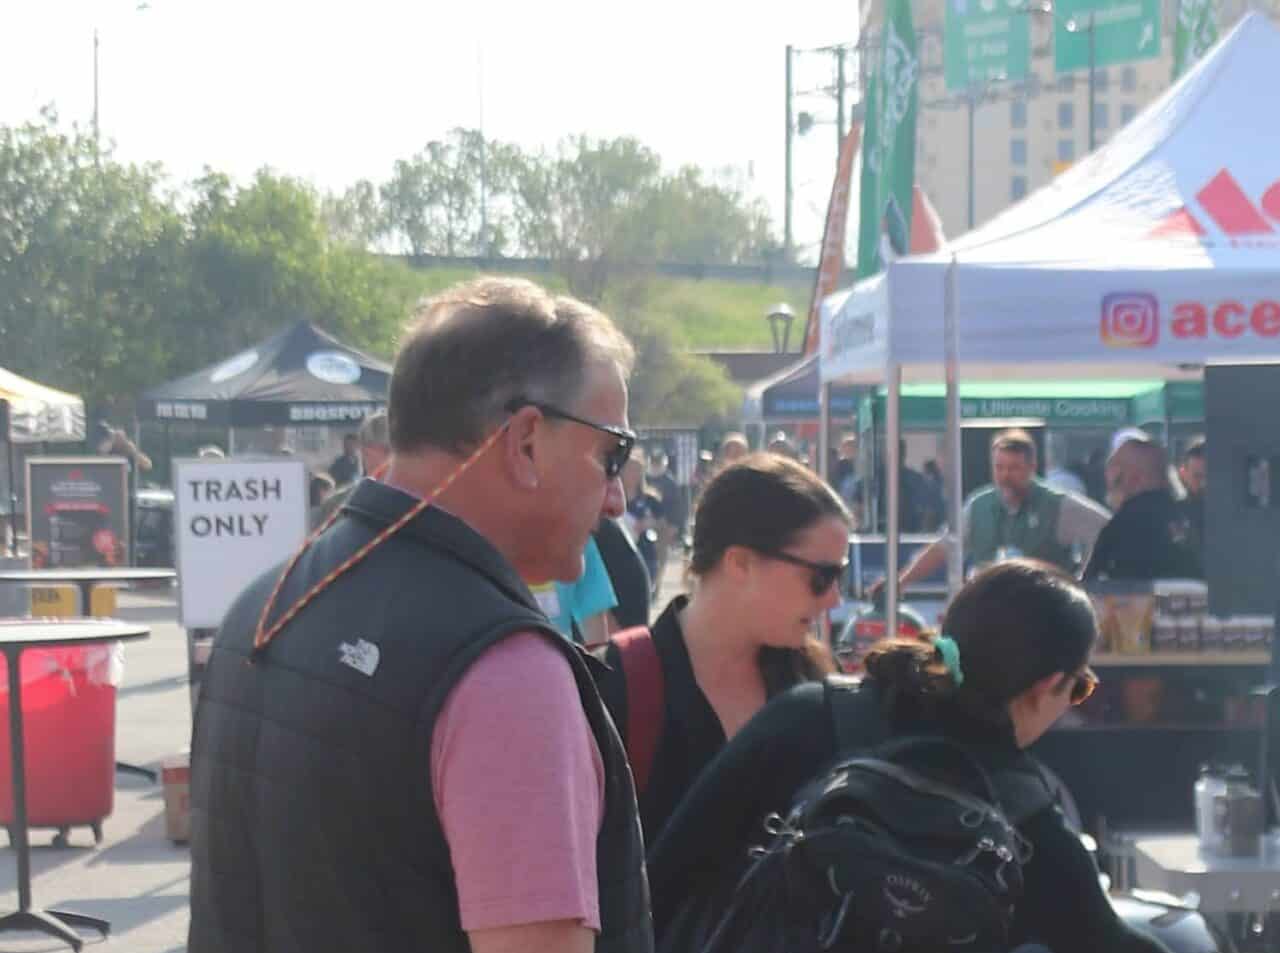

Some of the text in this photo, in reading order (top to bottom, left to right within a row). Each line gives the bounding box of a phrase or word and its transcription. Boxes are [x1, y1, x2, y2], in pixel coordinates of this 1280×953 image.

[1055, 401, 1127, 418] Cooking
[188, 479, 282, 501] TRASH
[189, 515, 269, 537] ONLY
